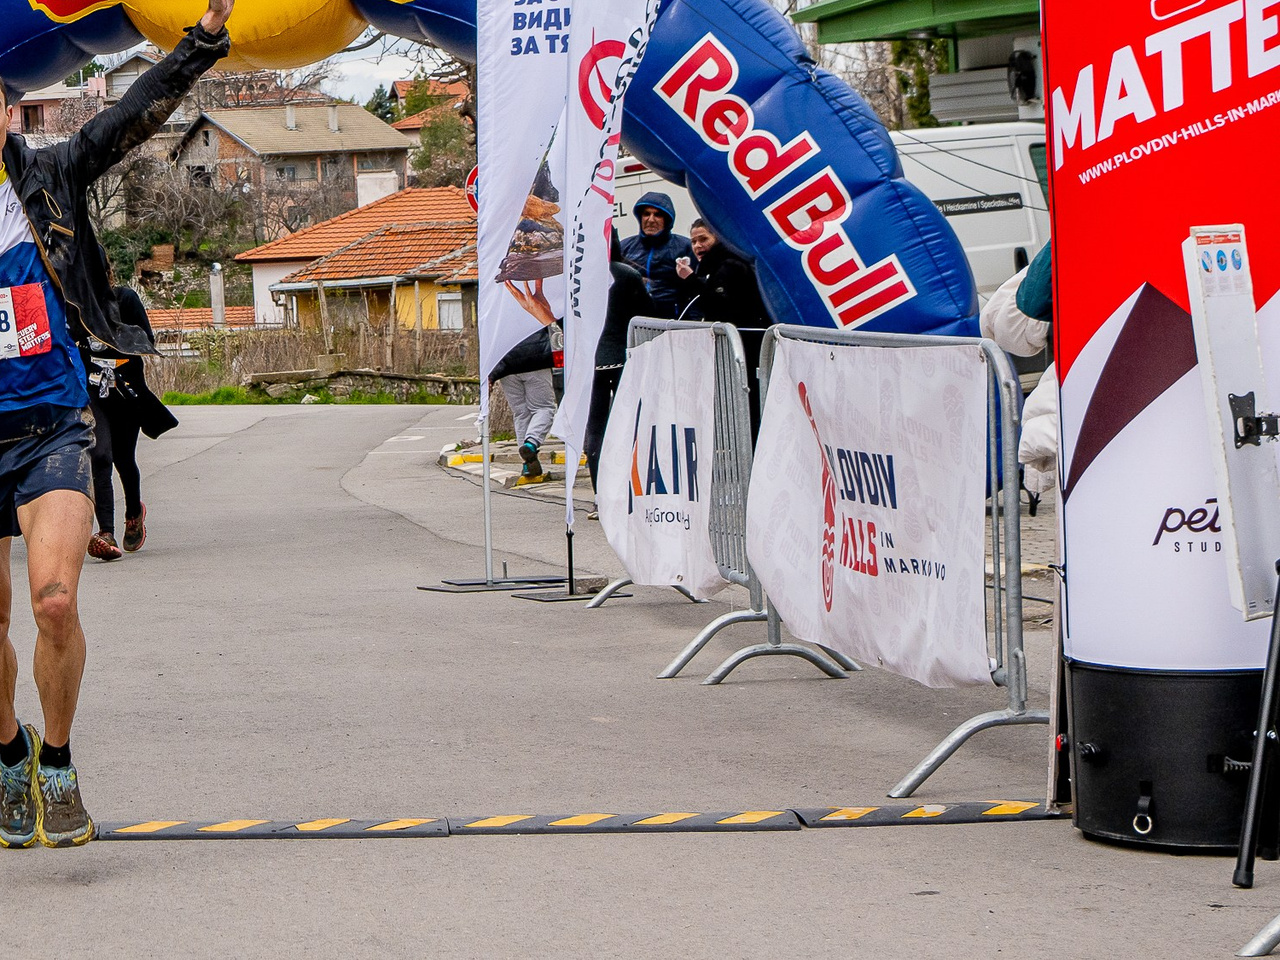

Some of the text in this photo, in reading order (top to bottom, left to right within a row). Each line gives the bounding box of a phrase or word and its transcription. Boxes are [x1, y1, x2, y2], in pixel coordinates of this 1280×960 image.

[510, 35, 540, 56] ЗА
[657, 36, 913, 330] Red Bull
[880, 531, 895, 549] IN
[1174, 541, 1222, 553] STUD
